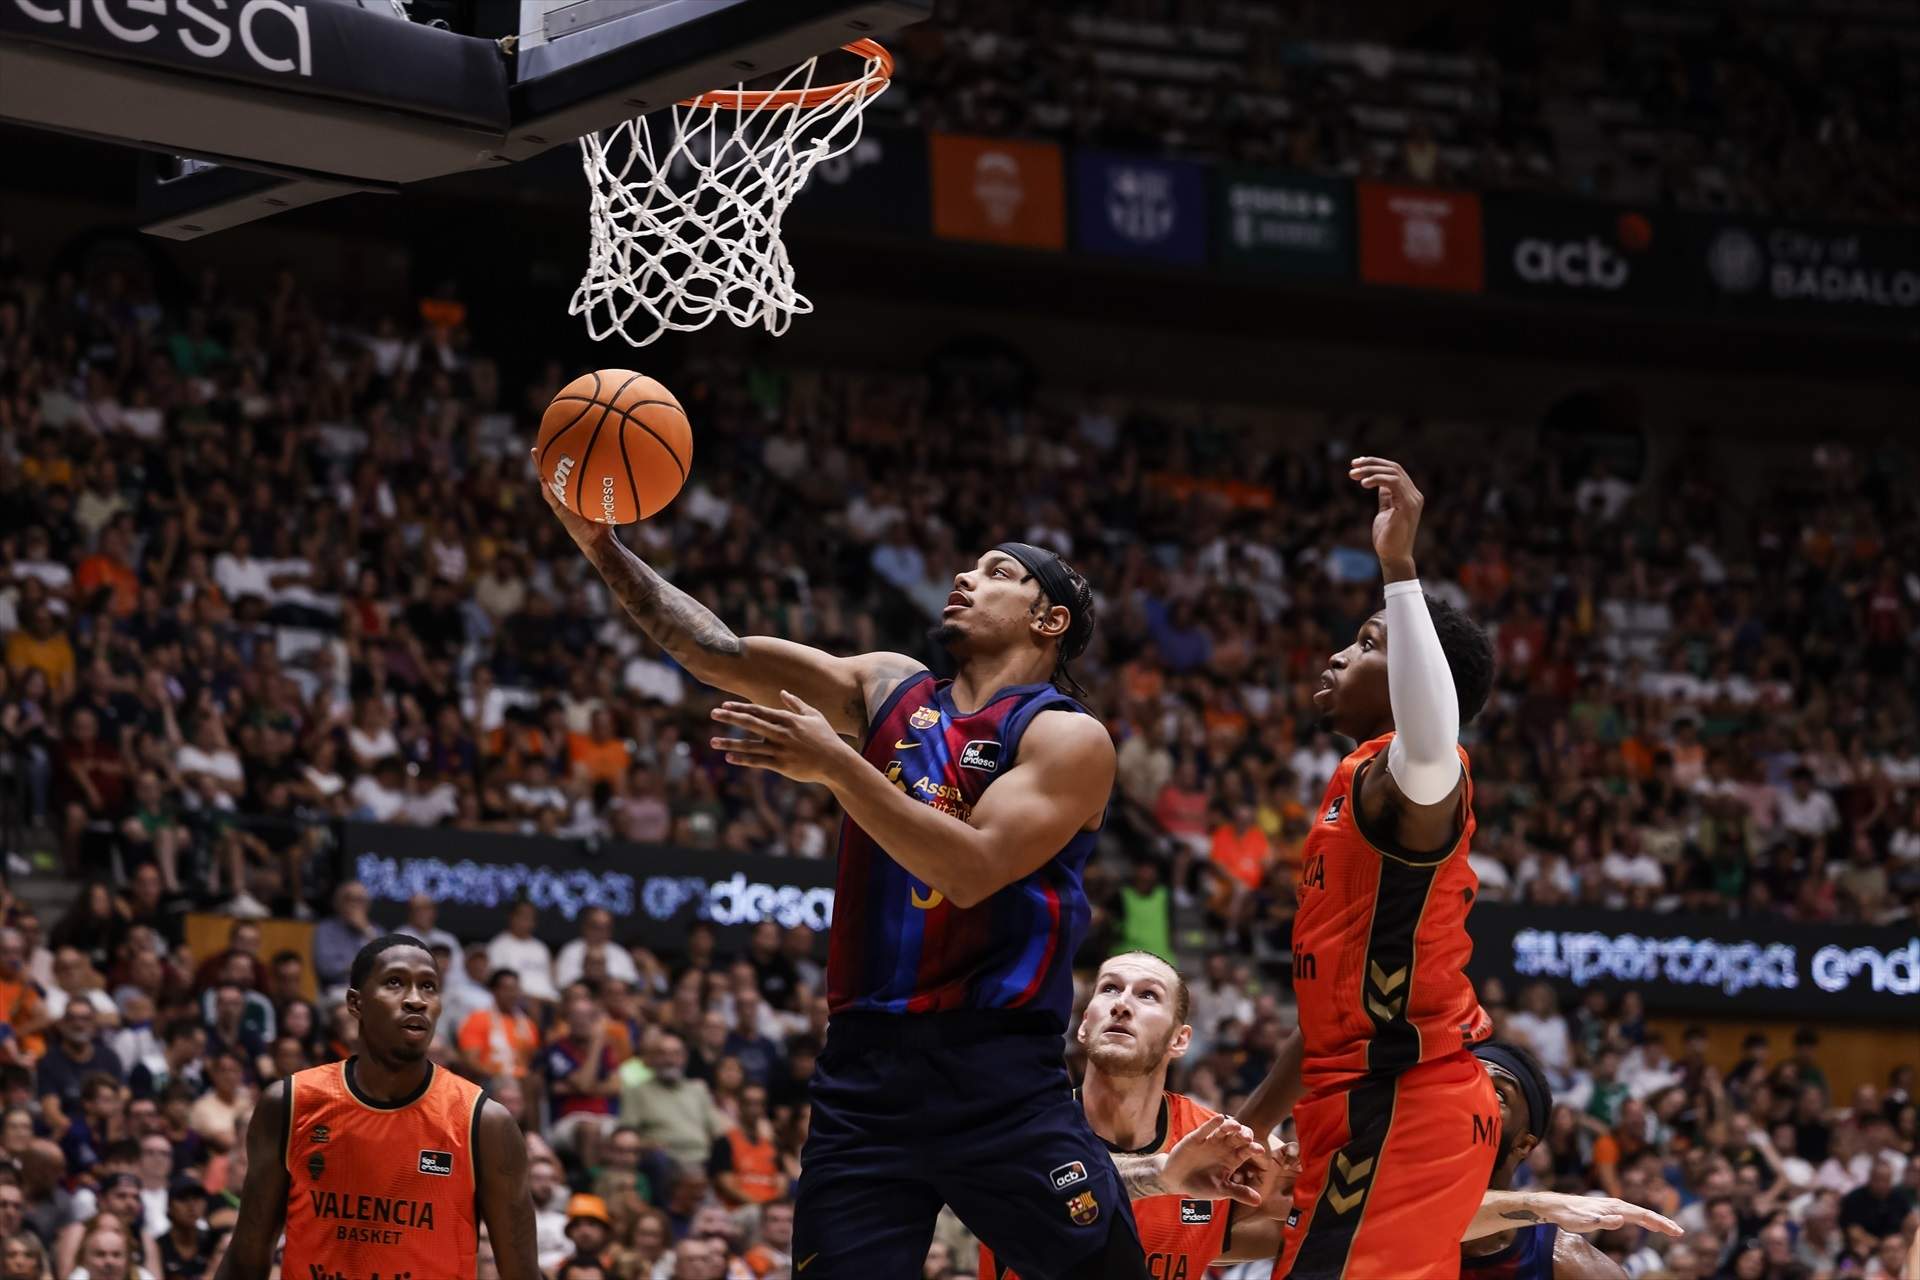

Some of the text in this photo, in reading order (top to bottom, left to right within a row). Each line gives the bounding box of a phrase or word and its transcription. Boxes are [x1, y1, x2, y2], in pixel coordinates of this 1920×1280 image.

[15, 0, 312, 76] esa
[1512, 235, 1631, 290] acb
[1825, 232, 1862, 265] of
[963, 757, 995, 767] endesa
[1056, 1171, 1080, 1187] acb
[310, 1190, 434, 1231] VALENCIA
[336, 1225, 403, 1245] BASKET
